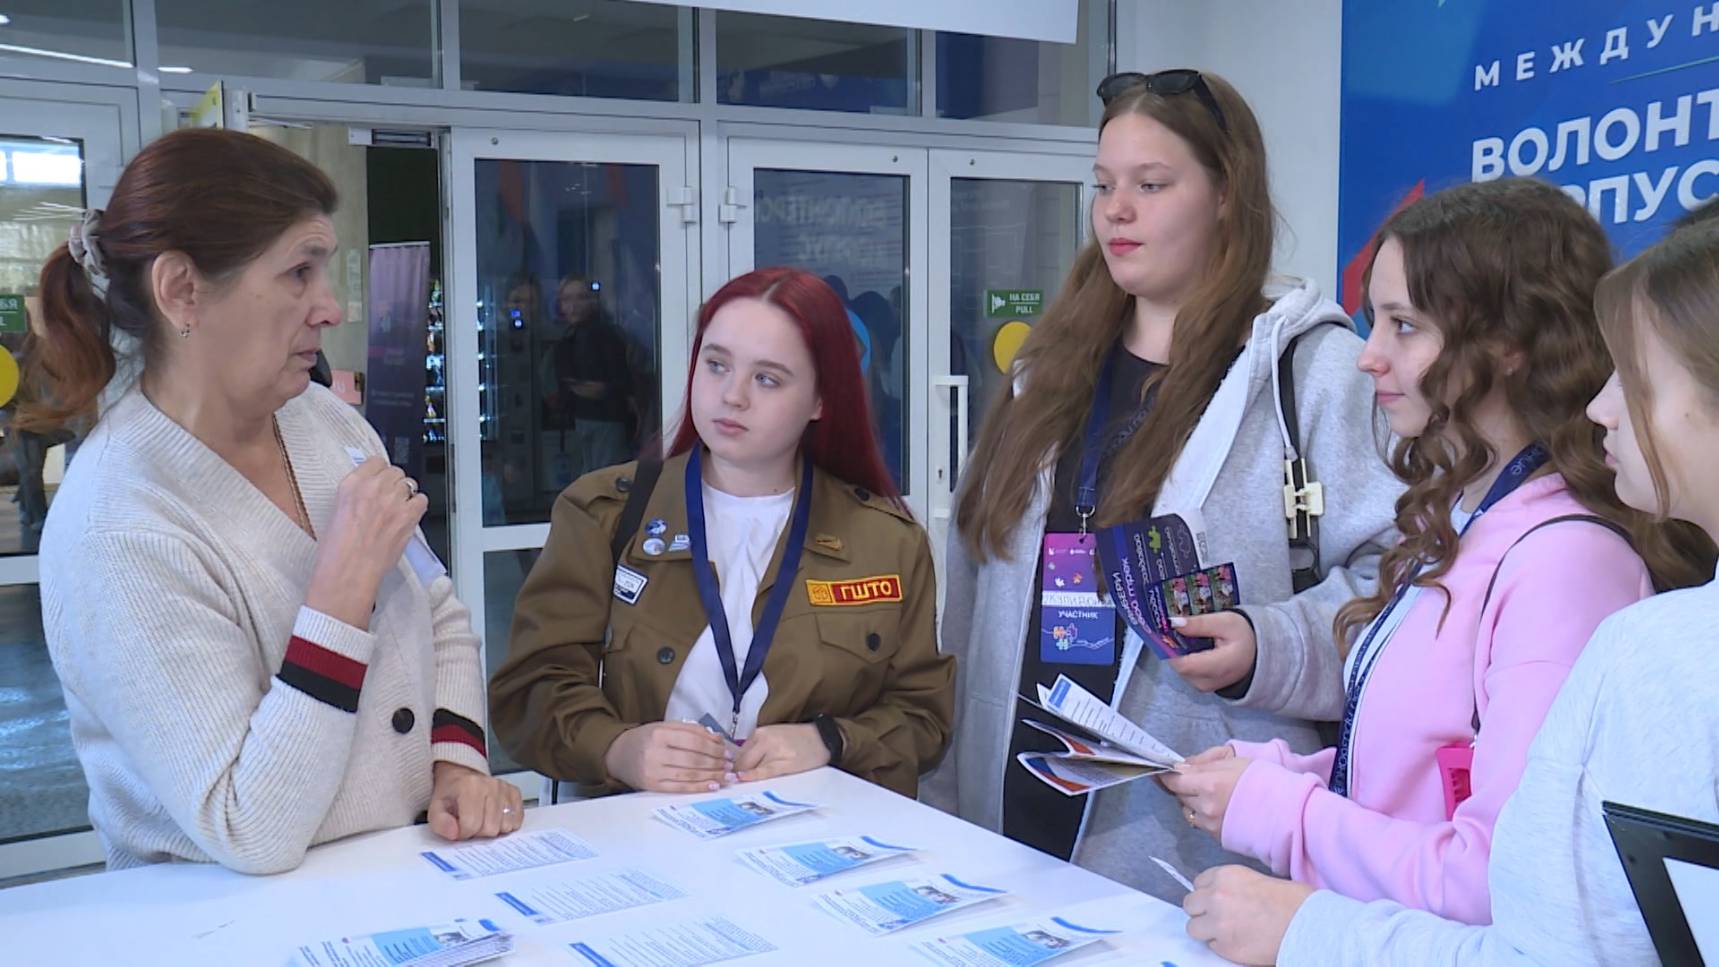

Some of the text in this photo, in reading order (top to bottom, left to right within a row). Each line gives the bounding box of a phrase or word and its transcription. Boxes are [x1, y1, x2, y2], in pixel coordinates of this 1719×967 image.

[1474, 1, 1719, 91] МЕЖДУН
[1472, 88, 1719, 183] ВОЛОНТ
[1009, 293, 1040, 301] НА СЕБЯ
[1015, 305, 1033, 314] PULL
[840, 580, 893, 600] ГШТО
[1057, 609, 1099, 620] УЧАСТНИК
